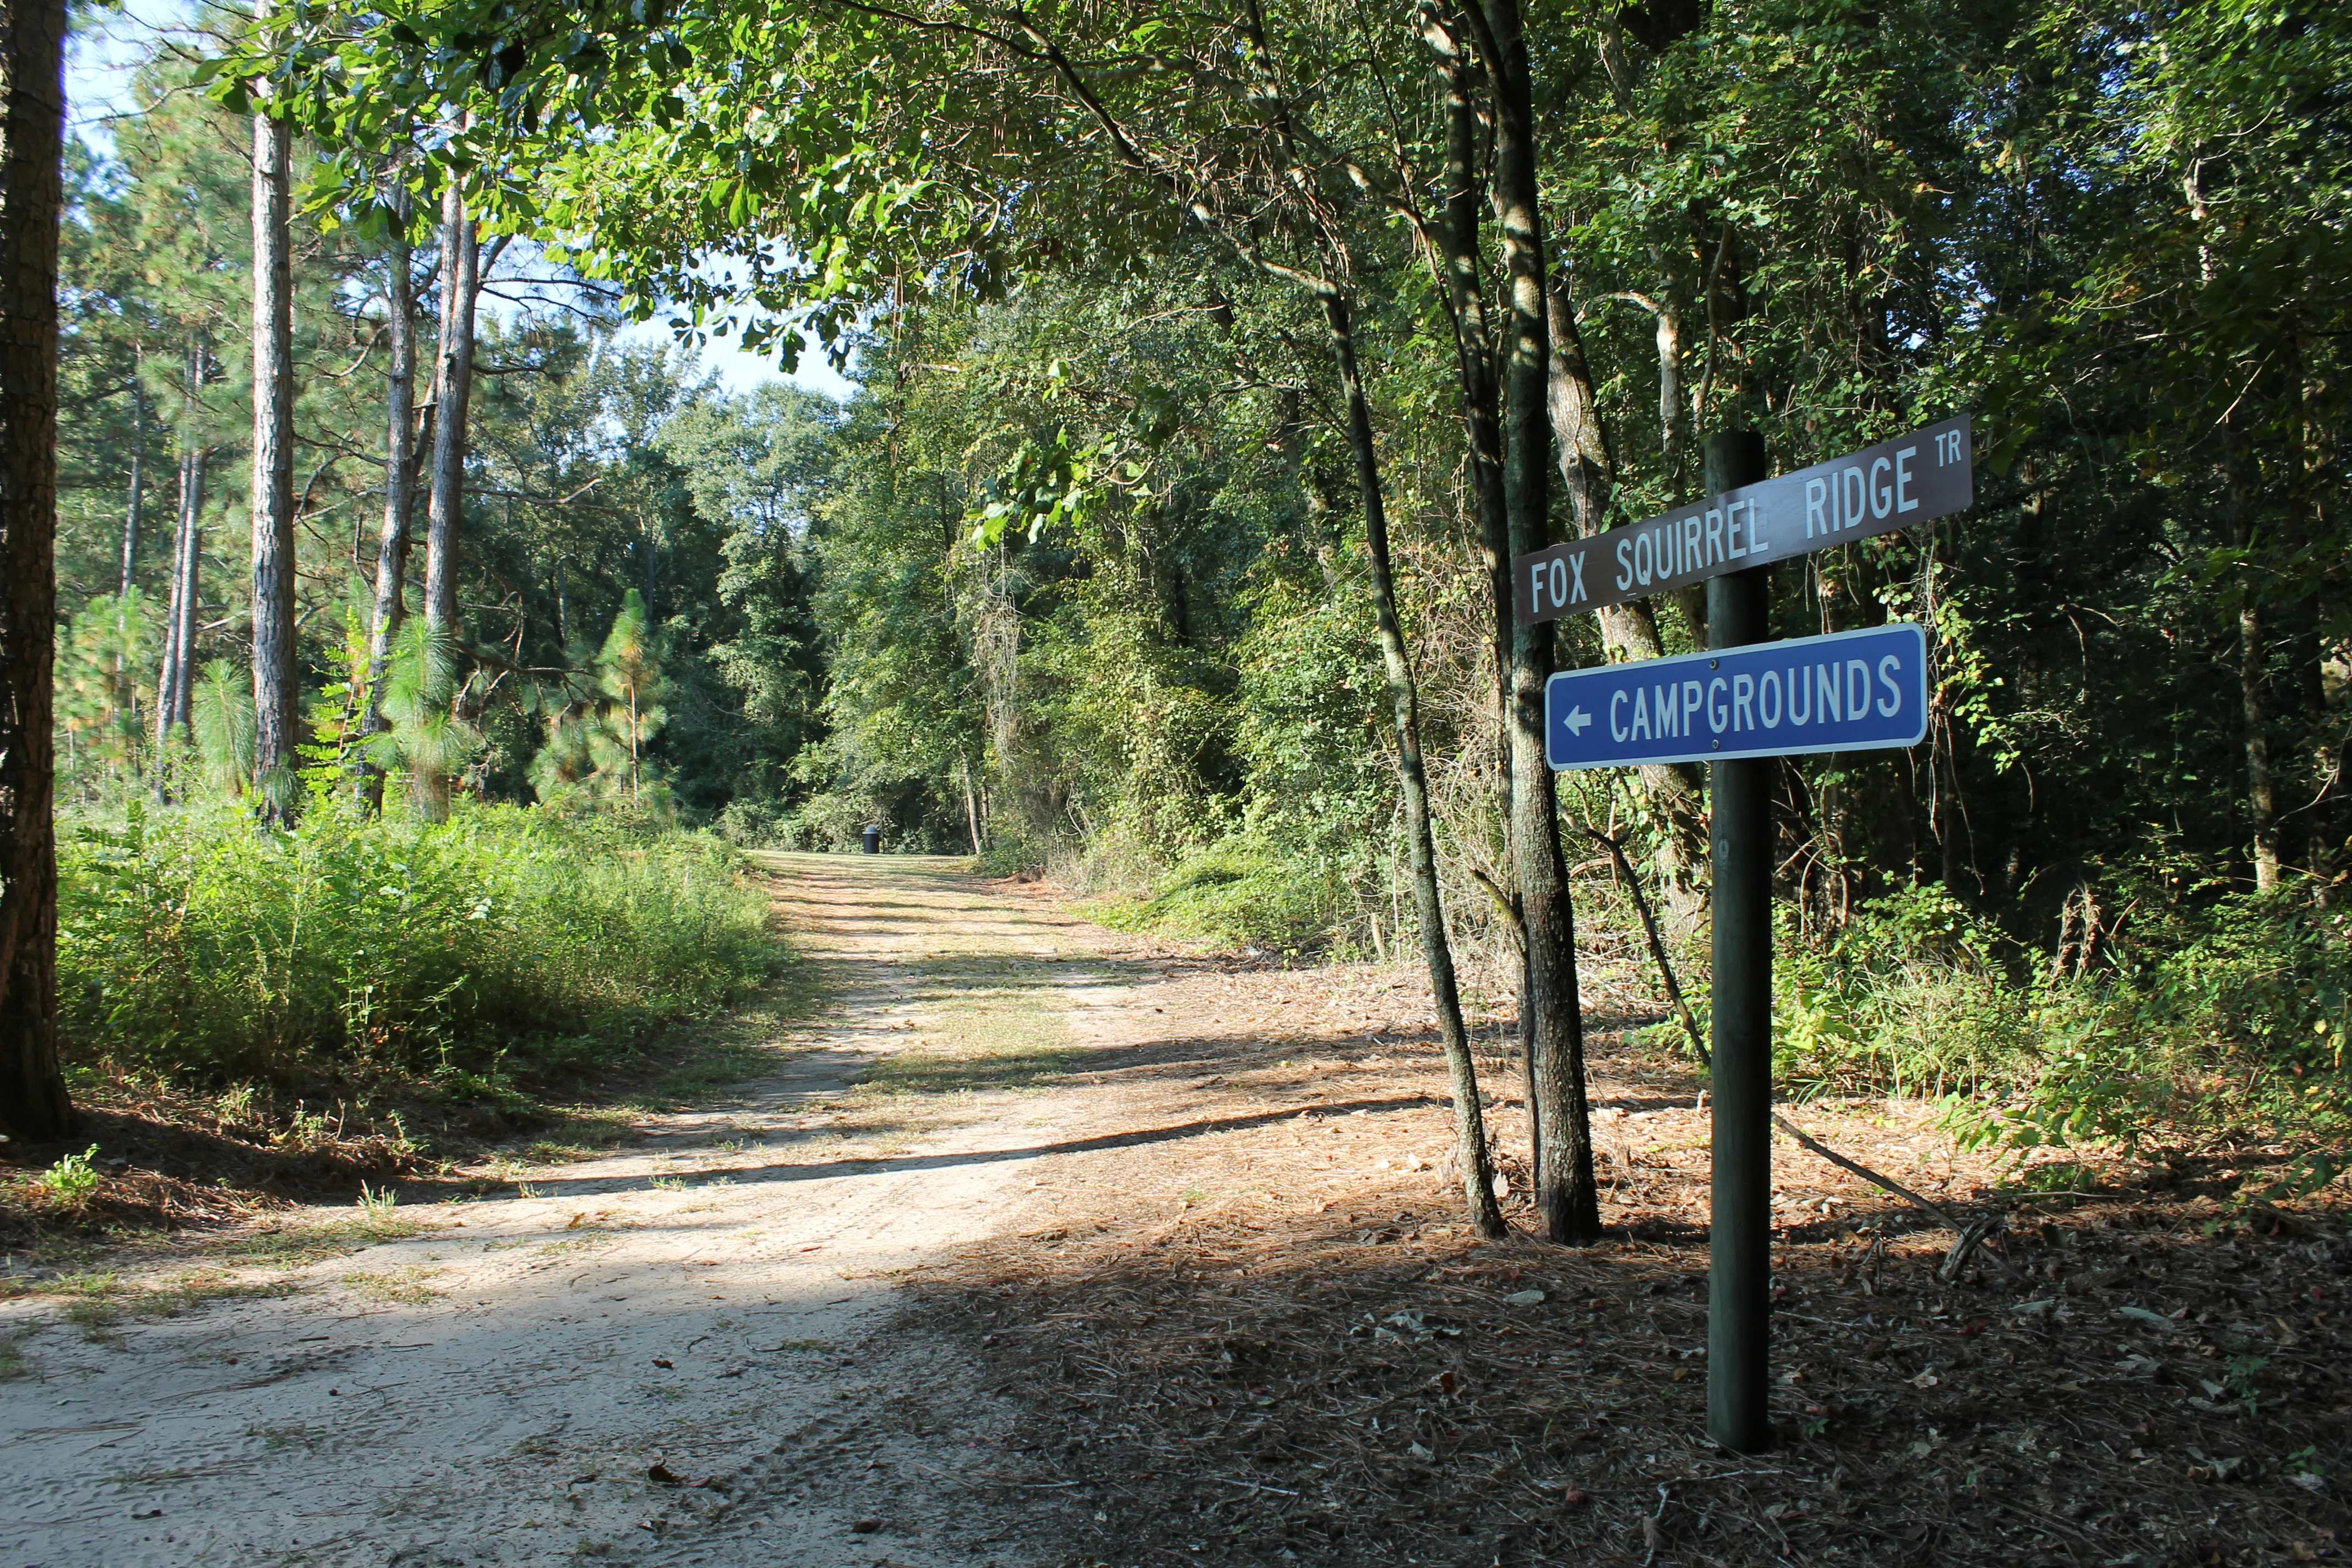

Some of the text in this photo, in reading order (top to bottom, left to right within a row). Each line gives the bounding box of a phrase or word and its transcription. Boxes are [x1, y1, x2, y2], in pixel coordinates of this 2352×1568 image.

[1531, 428, 1962, 613] FOX SQUIRREL RIDGE TR
[1610, 654, 1902, 743] CAMPGROUNDS
